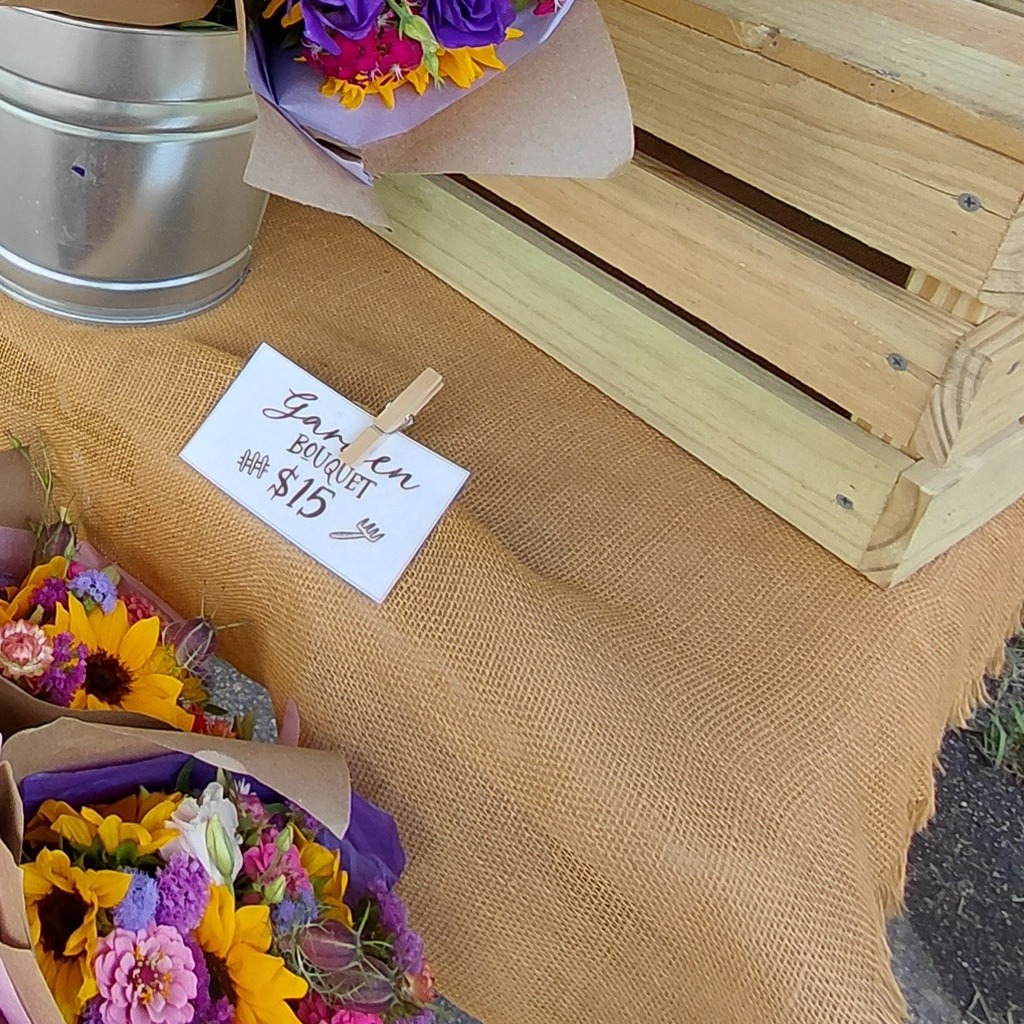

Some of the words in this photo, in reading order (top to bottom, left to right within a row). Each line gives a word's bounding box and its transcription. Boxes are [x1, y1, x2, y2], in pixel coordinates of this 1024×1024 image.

[262, 388, 421, 491] Garen
[286, 433, 378, 499] BOUQUET
[267, 464, 337, 519] $15
